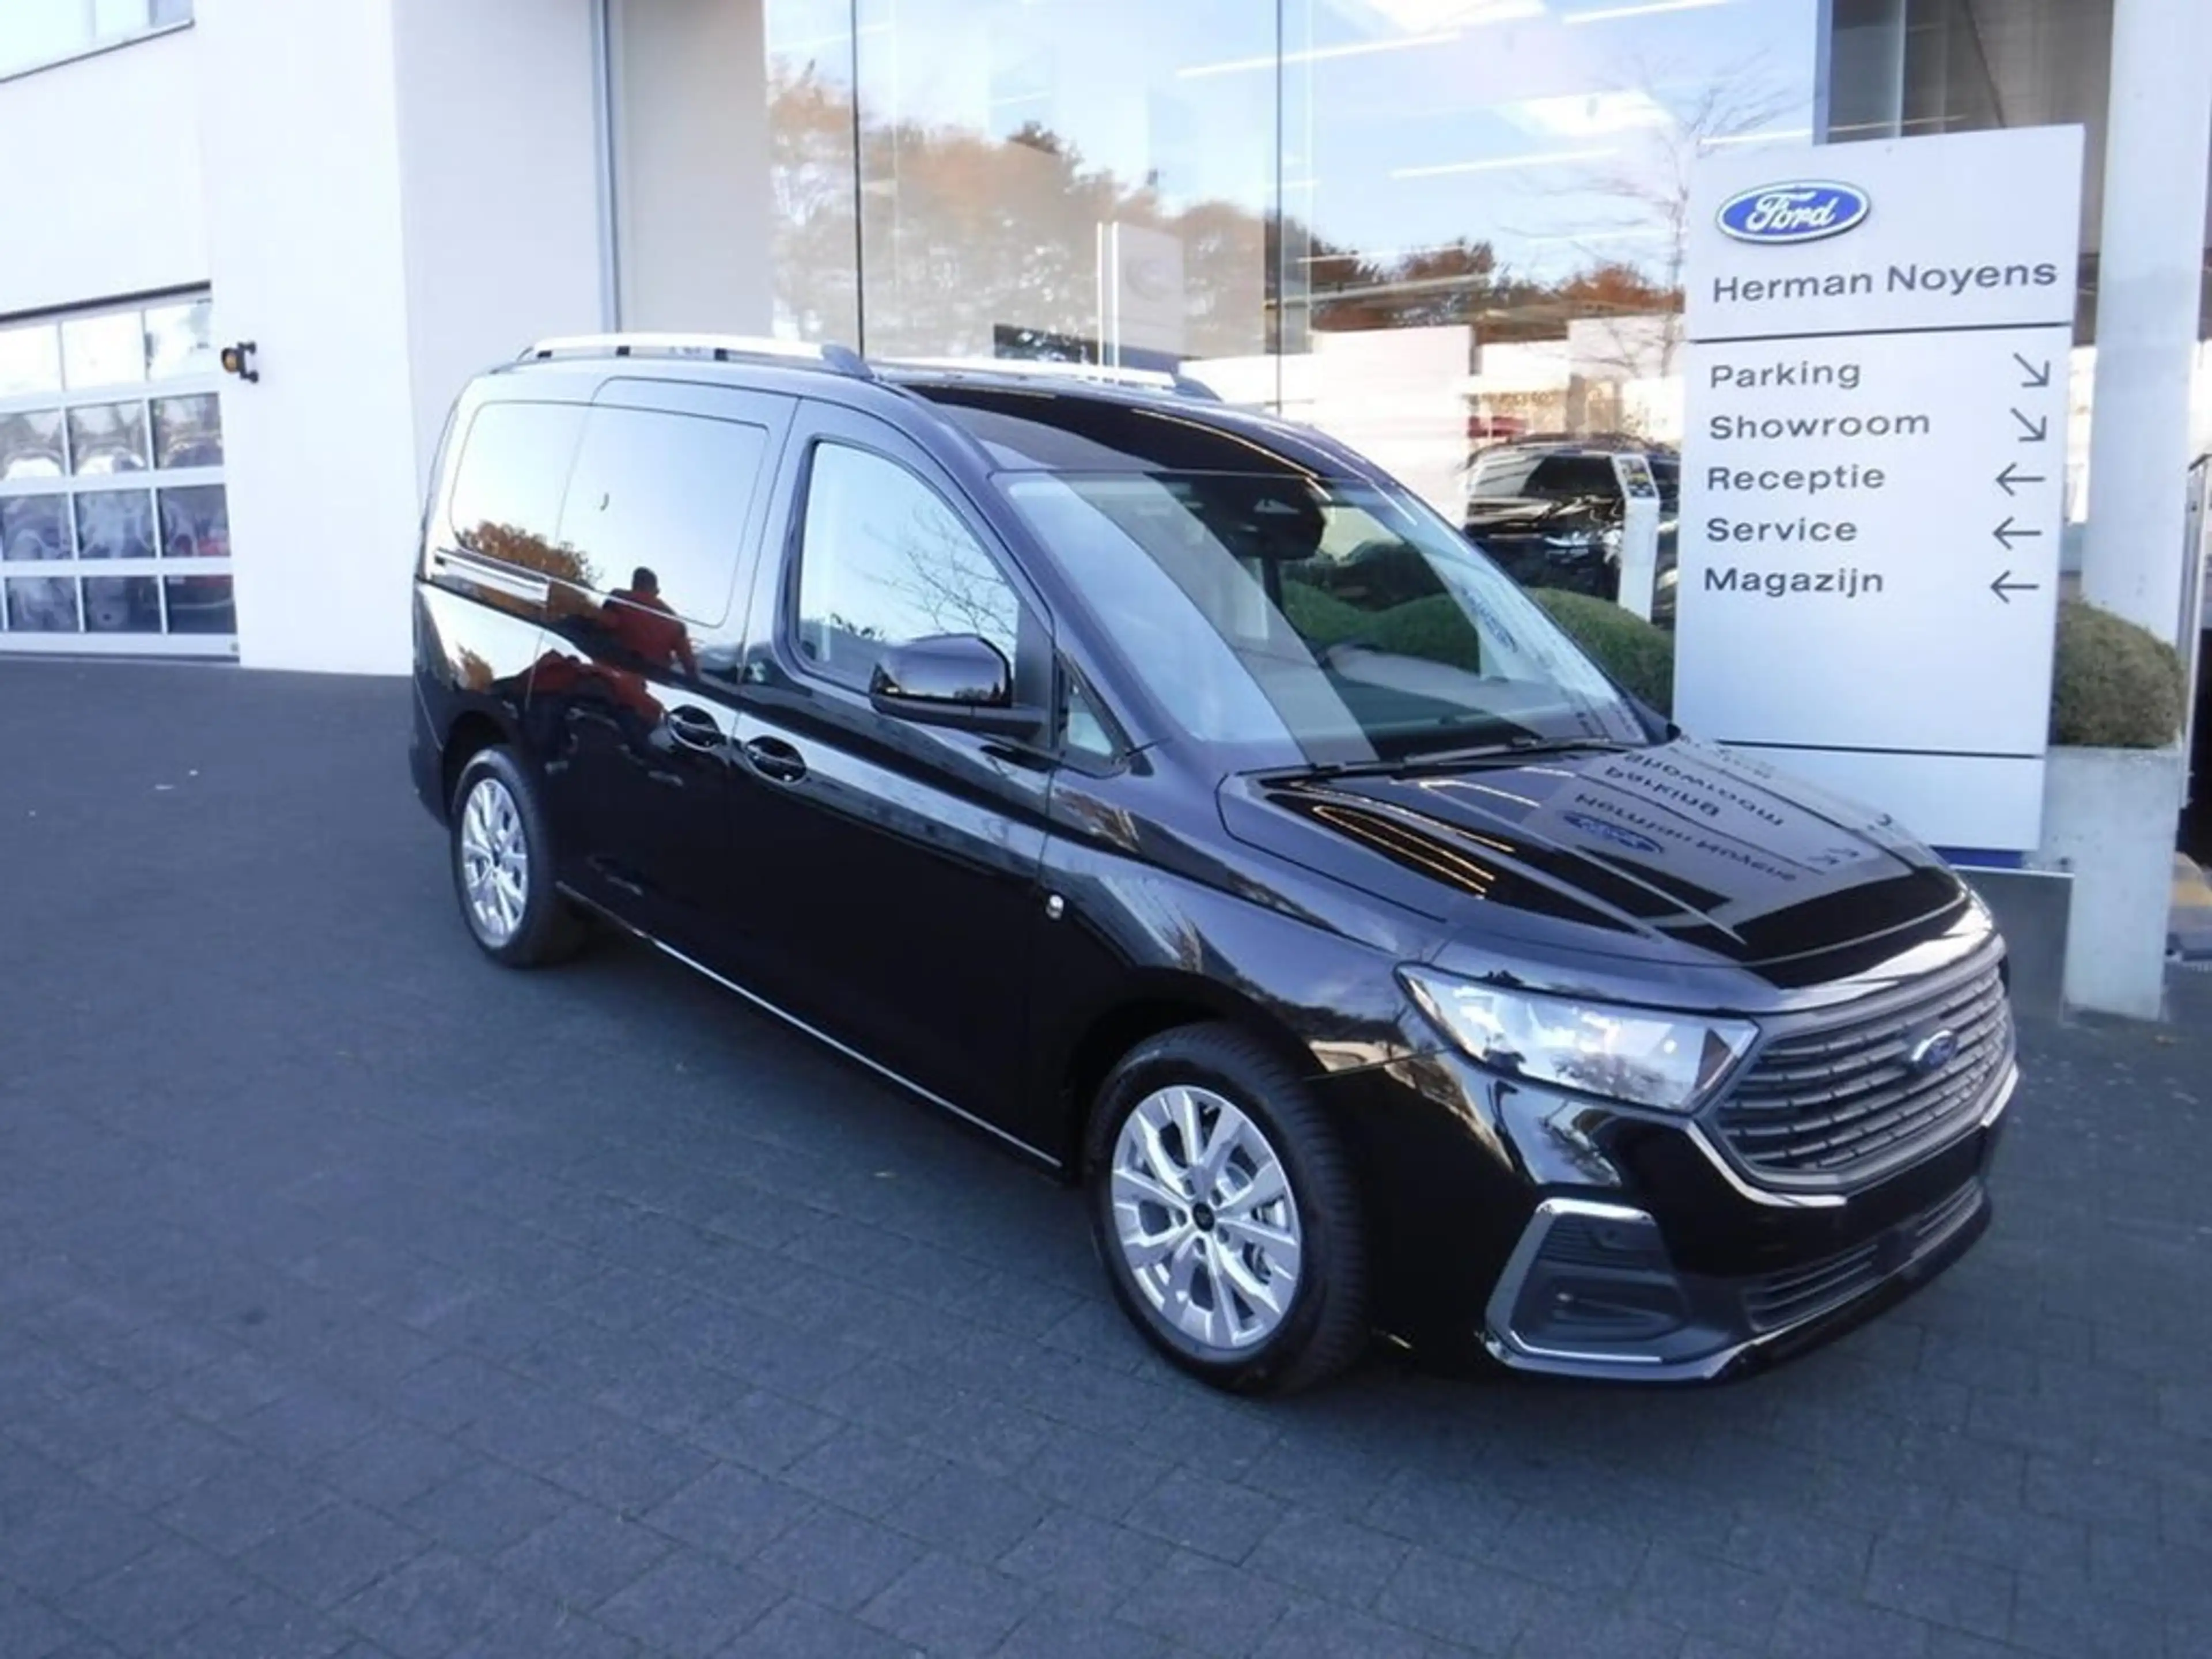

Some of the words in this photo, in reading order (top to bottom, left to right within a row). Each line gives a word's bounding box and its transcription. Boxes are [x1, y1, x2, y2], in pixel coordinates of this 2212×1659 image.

[1744, 191, 1838, 231] Ford
[1713, 272, 1872, 302] Herman
[1887, 262, 2058, 294] Noyens
[1710, 361, 1861, 389] Parking
[1709, 414, 1929, 440] Showroom
[1707, 464, 1885, 494] Receptie
[1707, 518, 1858, 541] Service
[1704, 568, 1883, 598] Magazijn
